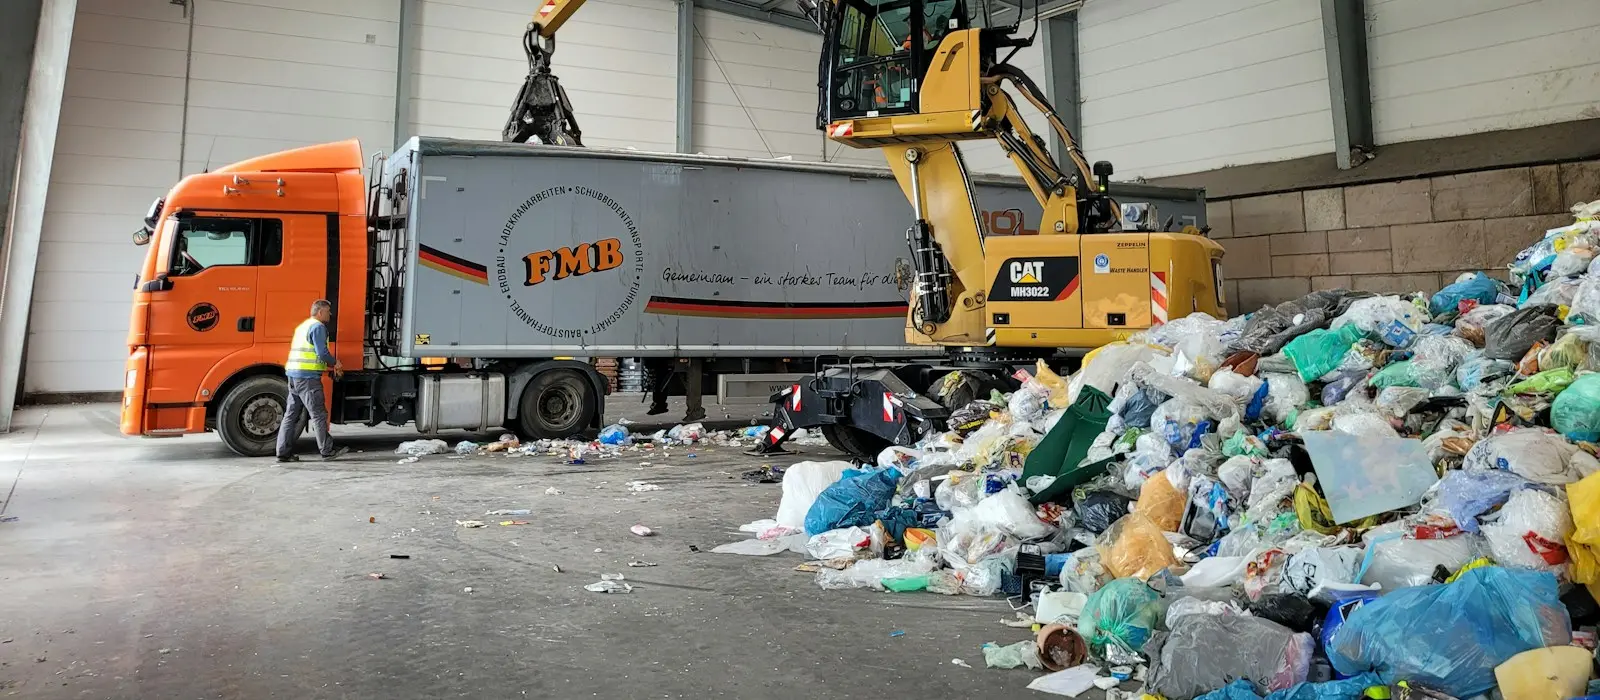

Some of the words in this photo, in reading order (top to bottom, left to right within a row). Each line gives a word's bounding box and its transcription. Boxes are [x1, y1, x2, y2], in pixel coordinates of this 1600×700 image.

[501, 185, 566, 246] LADEKRANARBEITEN
[496, 256, 510, 293] ERDBAU
[522, 237, 624, 287] FMB
[662, 267, 735, 285] Gemeinsam
[754, 272, 773, 285] ein
[777, 271, 822, 286] starkes
[825, 272, 857, 286] Team
[860, 271, 880, 291] für
[1010, 261, 1045, 283] CAT
[591, 281, 640, 335] FUHRGESCHÄFT
[1010, 286, 1050, 297] MH3022
[509, 299, 582, 338] BAUSTOFFHANDEL
